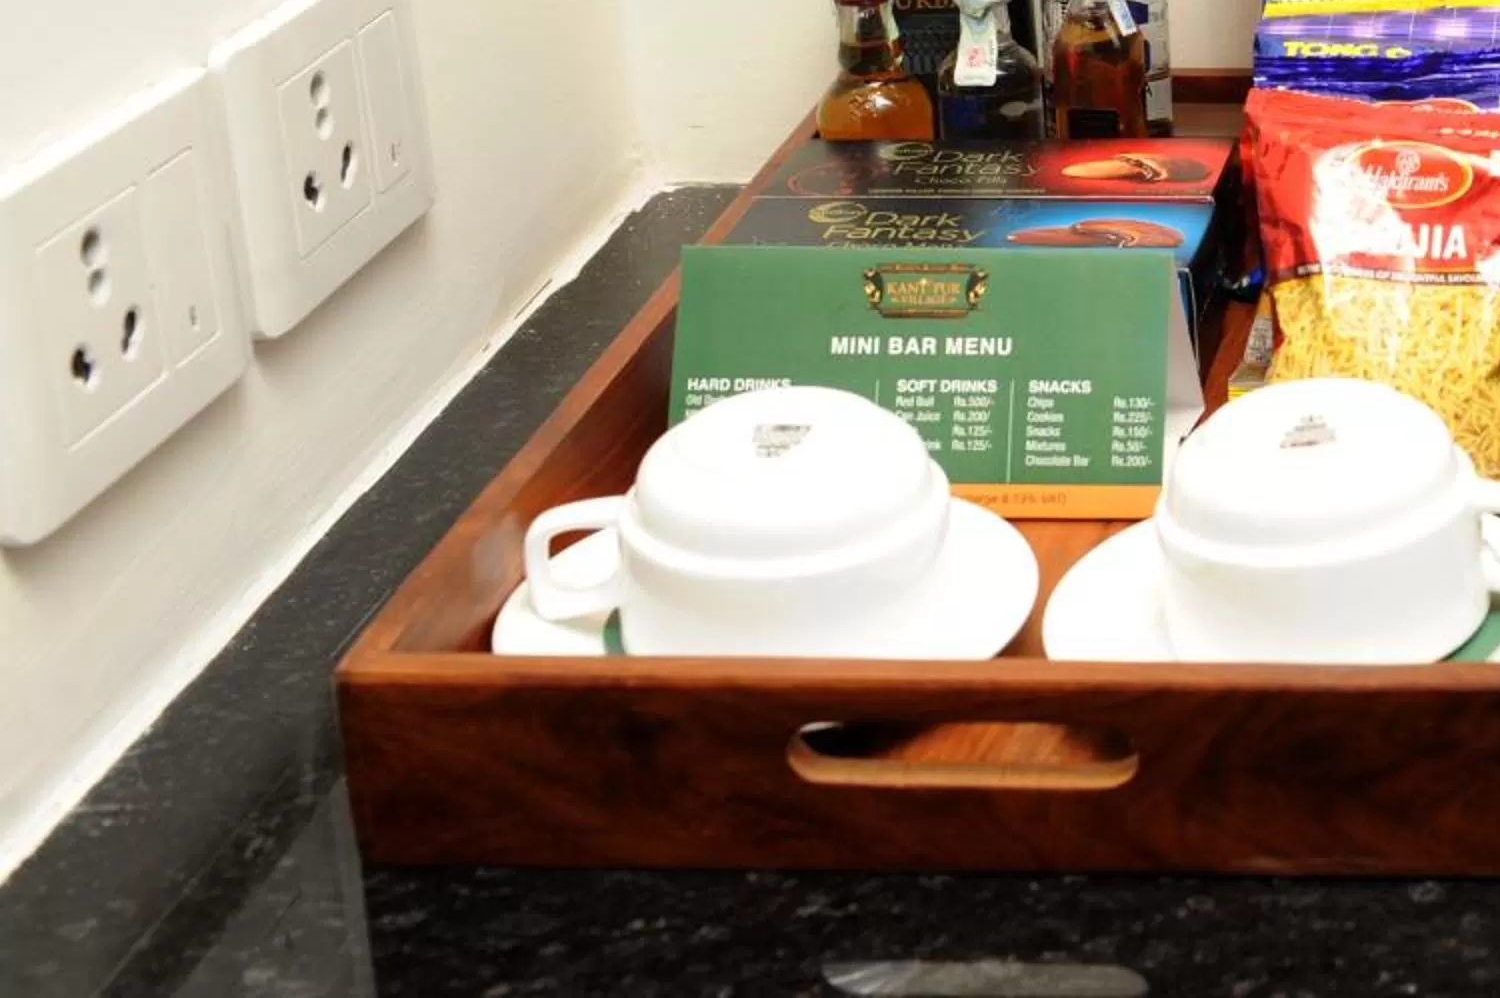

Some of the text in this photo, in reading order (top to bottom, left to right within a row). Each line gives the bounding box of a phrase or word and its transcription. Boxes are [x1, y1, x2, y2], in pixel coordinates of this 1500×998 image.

[933, 150, 1023, 163] Dark
[893, 161, 1042, 177] Fantasy
[864, 211, 962, 226] Dark
[822, 225, 986, 243] Fantasy
[831, 337, 1012, 355] MINI BAR MENU
[687, 378, 792, 391] HARD DRINKS
[896, 379, 998, 393] SOFT DRINKS
[1028, 379, 1092, 394] SNACKS
